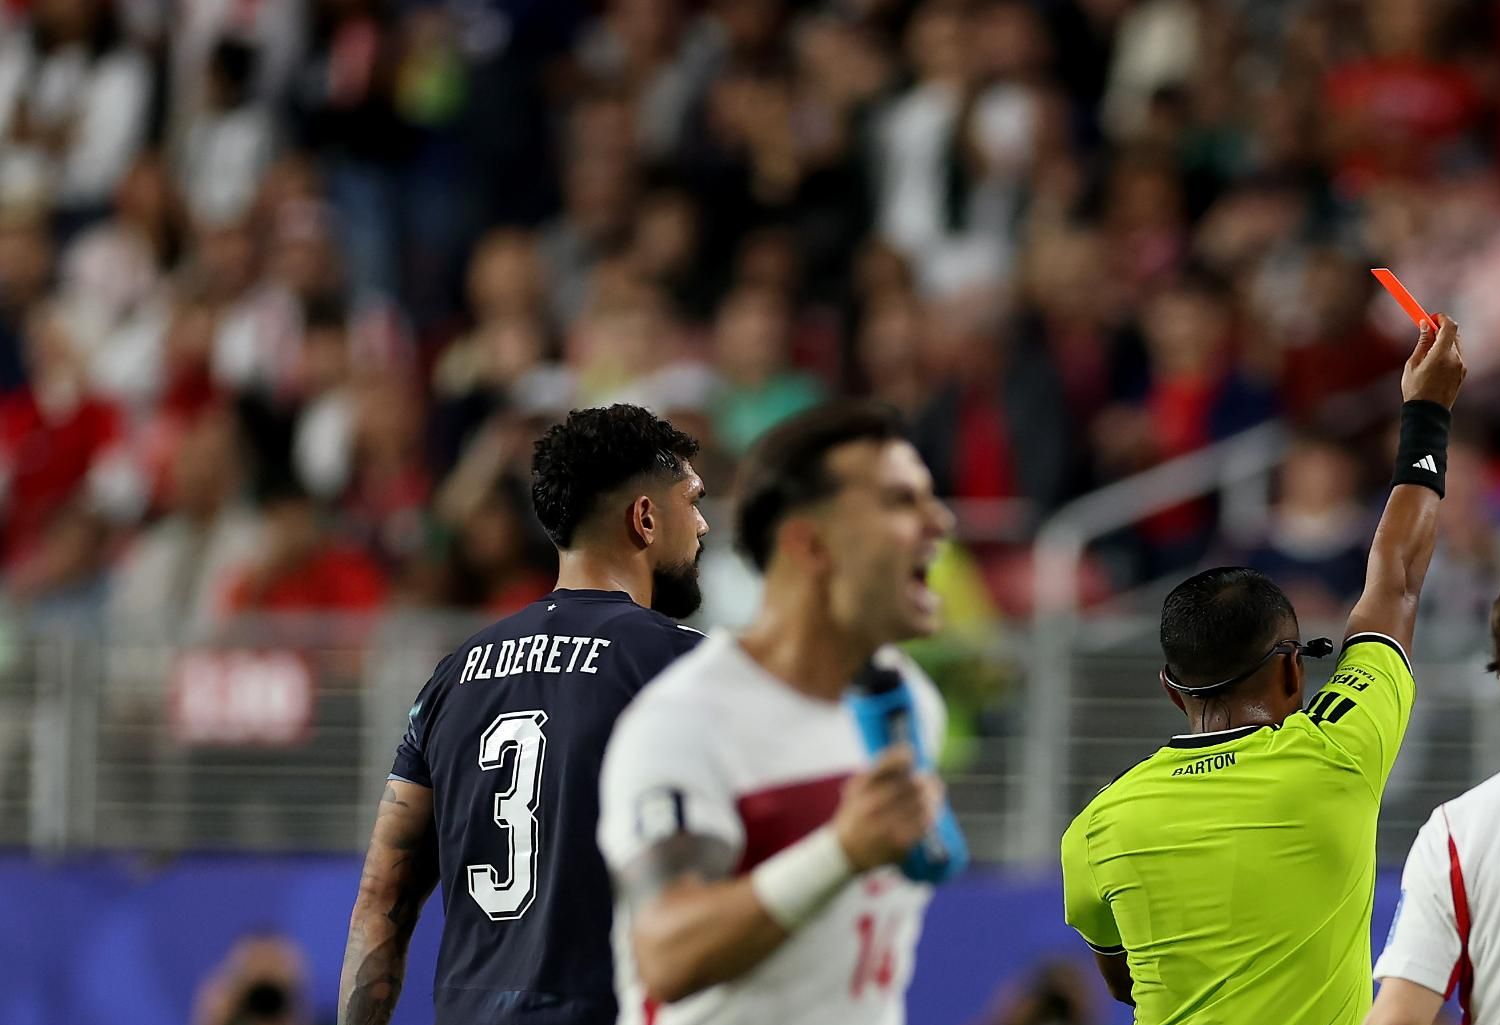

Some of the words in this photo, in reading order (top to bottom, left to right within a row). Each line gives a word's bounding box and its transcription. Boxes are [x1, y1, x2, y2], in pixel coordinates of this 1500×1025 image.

[459, 633, 612, 685] ALDERETE
[1171, 752, 1236, 777] BARTON
[467, 709, 549, 922] 3
